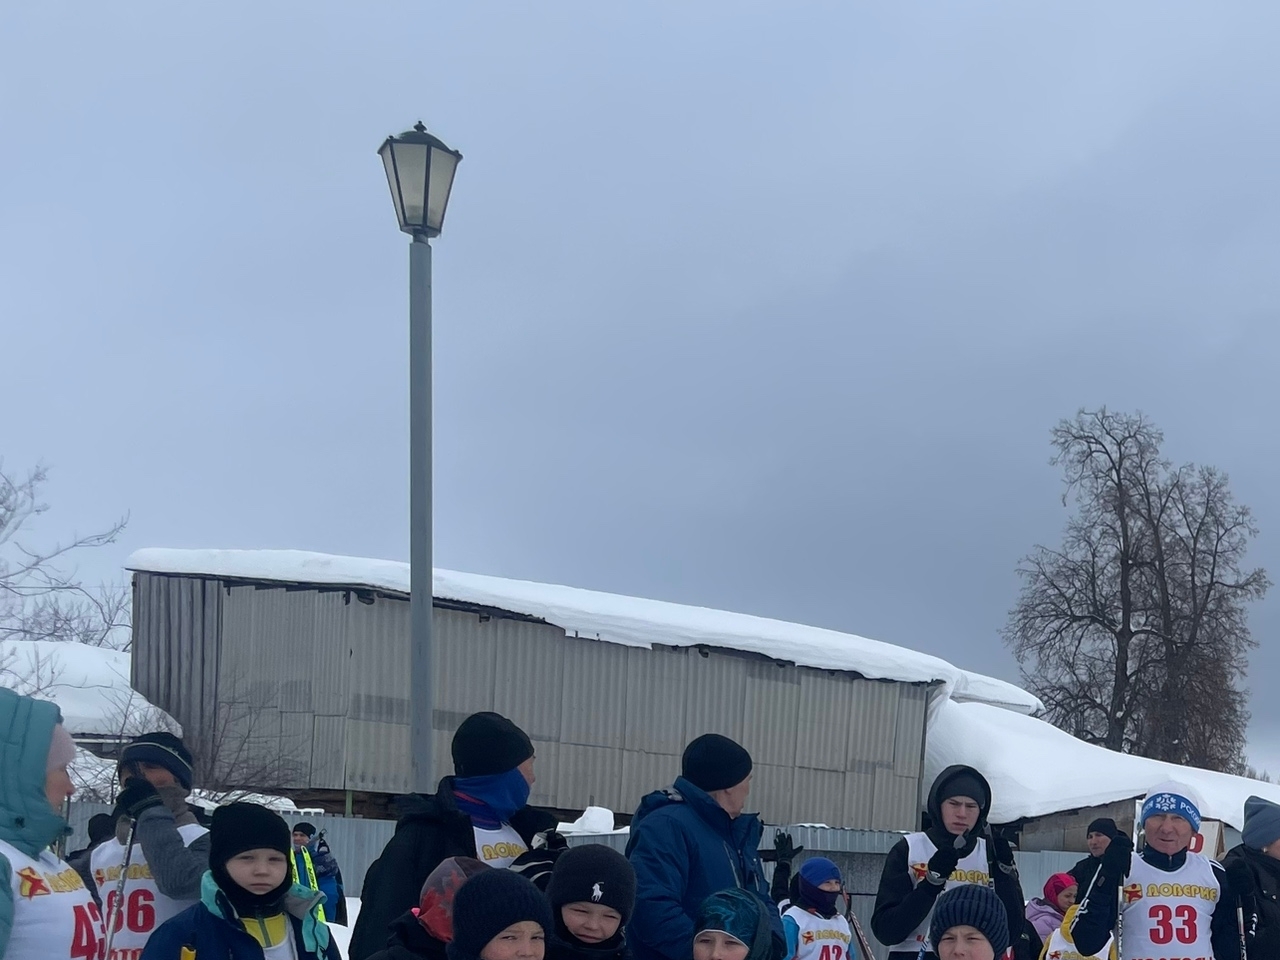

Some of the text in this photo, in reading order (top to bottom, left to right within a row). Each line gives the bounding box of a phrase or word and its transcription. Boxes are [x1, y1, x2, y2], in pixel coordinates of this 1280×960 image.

[107, 889, 155, 933] 86
[1147, 883, 1217, 901] ДОВЕРИЕ
[1149, 905, 1197, 944] 33
